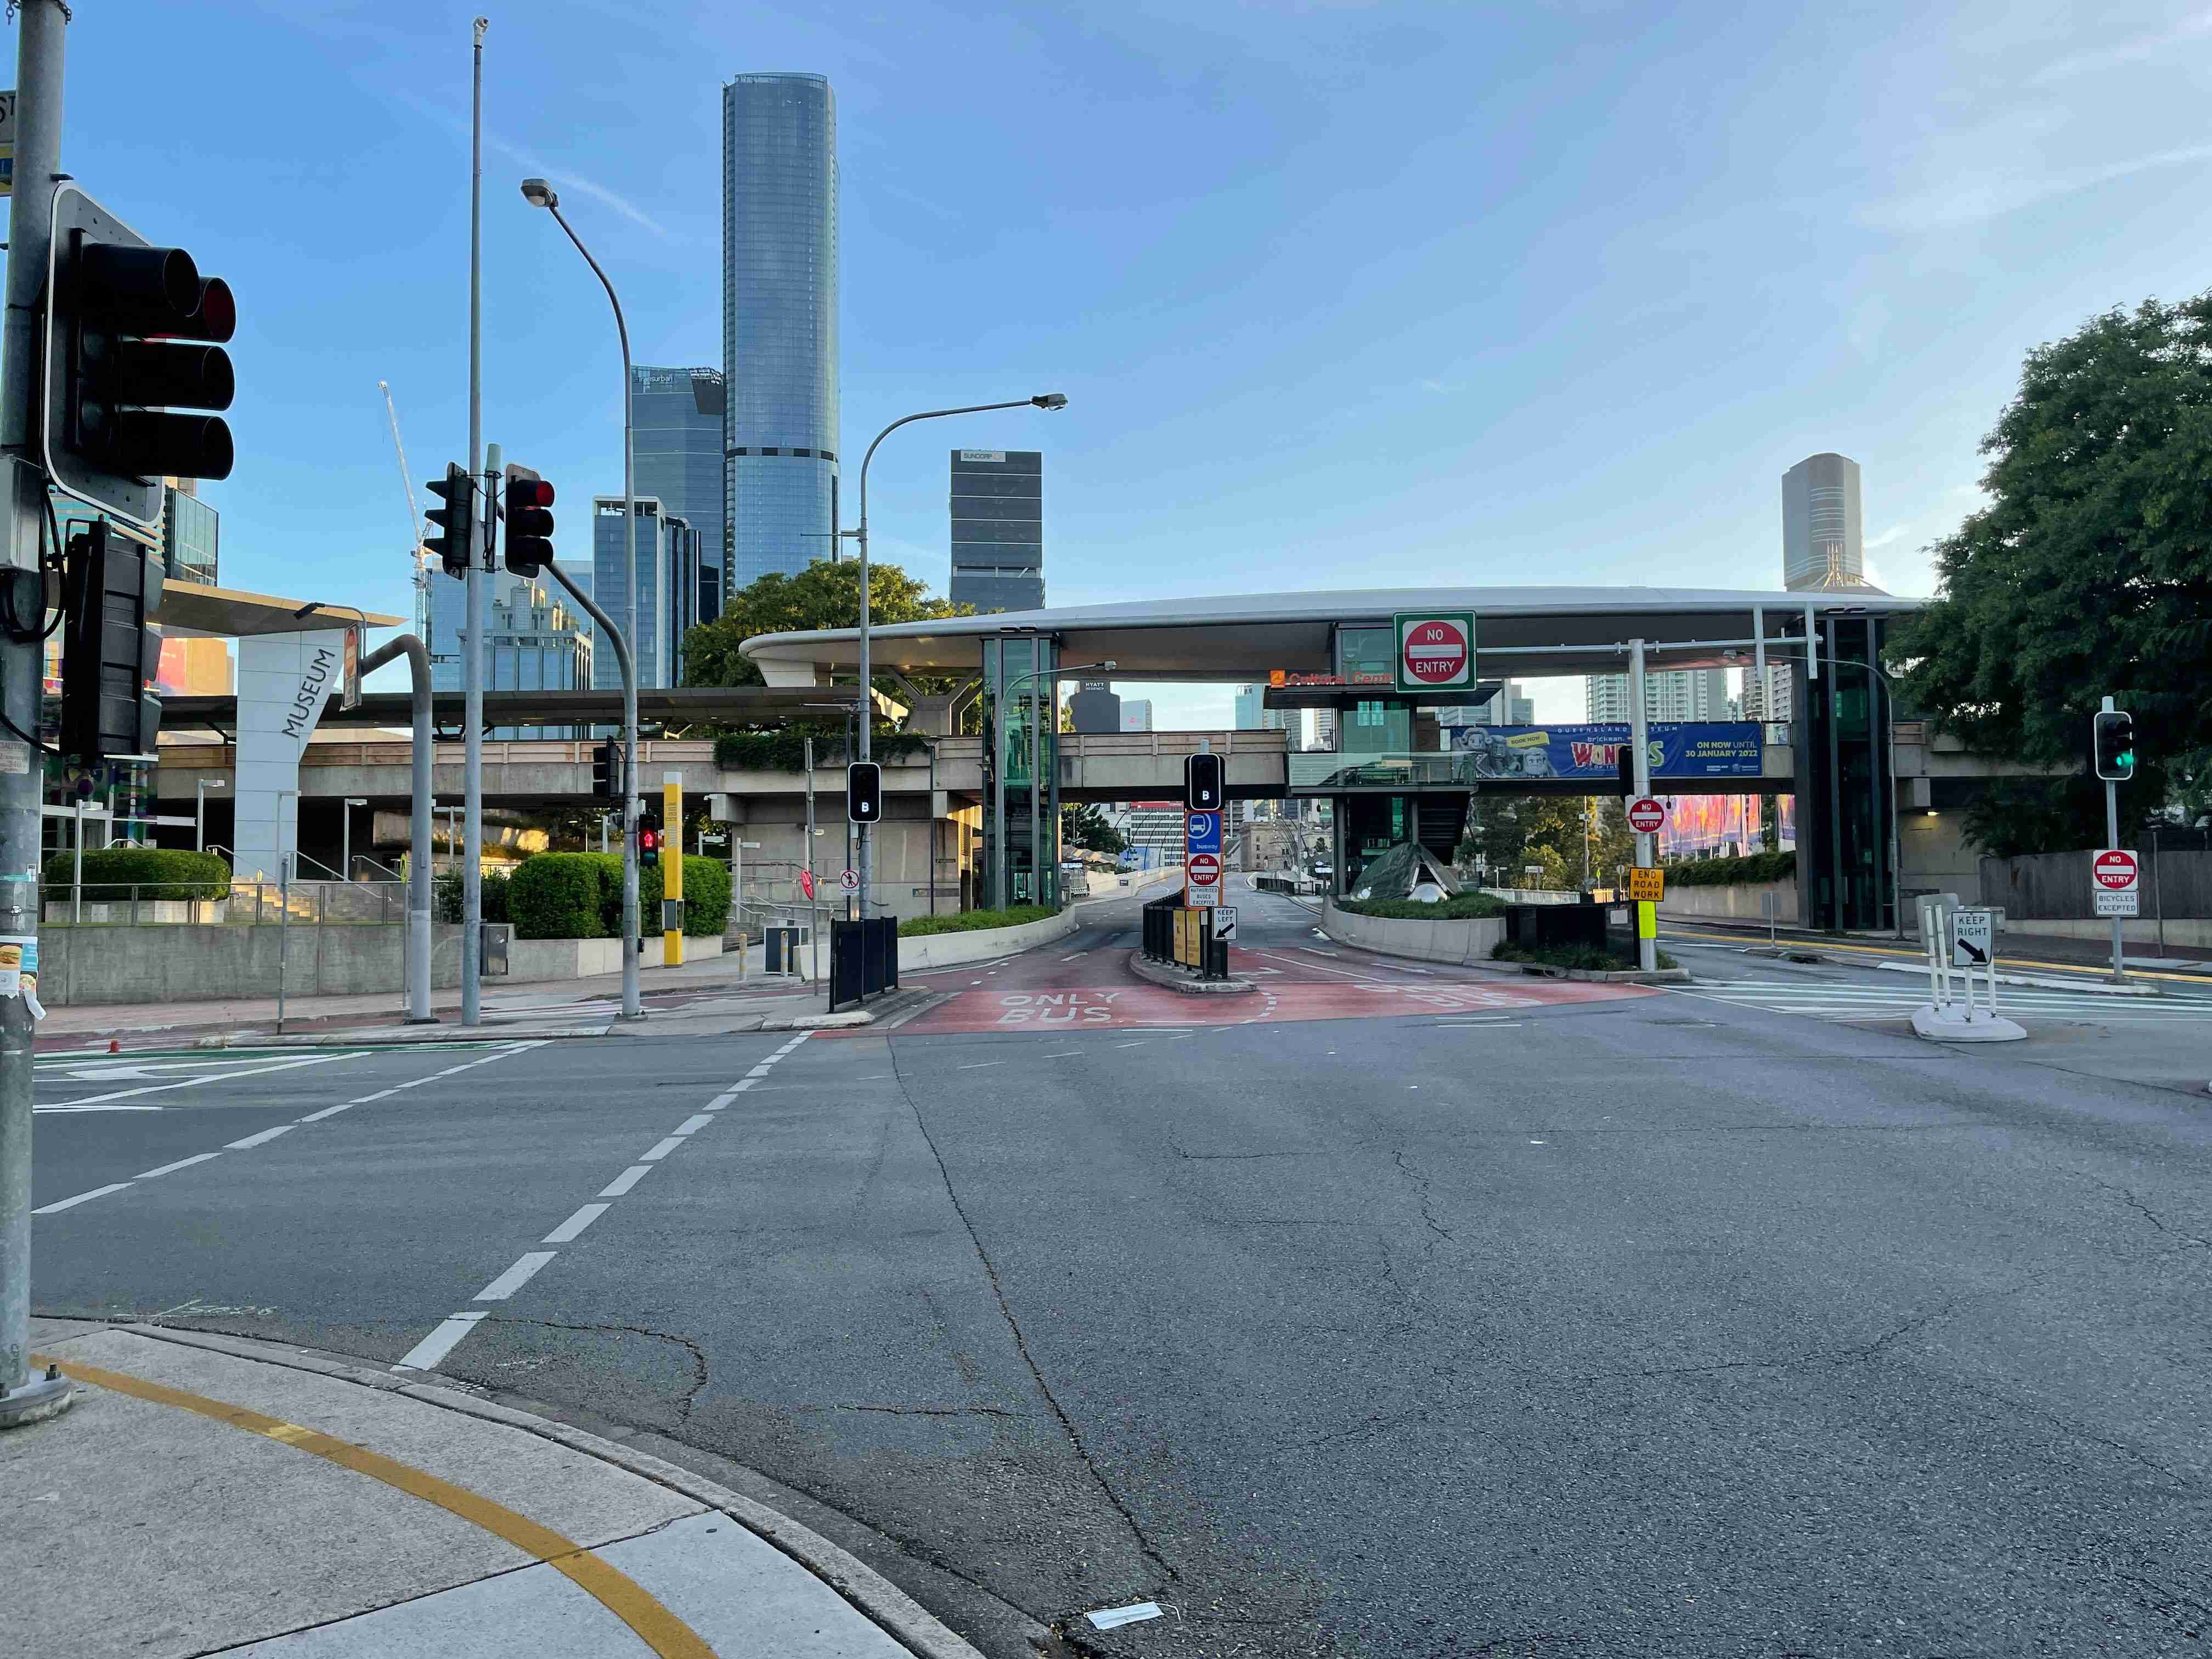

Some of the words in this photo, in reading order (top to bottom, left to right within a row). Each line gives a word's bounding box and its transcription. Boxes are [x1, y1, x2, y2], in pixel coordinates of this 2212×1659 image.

[1426, 629, 1443, 641] NO
[1416, 661, 1455, 673] ENTRY
[281, 648, 335, 738] MUSEUM
[1203, 791, 1209, 800] B
[862, 802, 869, 812] B
[1959, 916, 1984, 924] KEEP
[1000, 992, 1124, 1006] ONLY
[996, 1007, 1111, 1024] BUS
